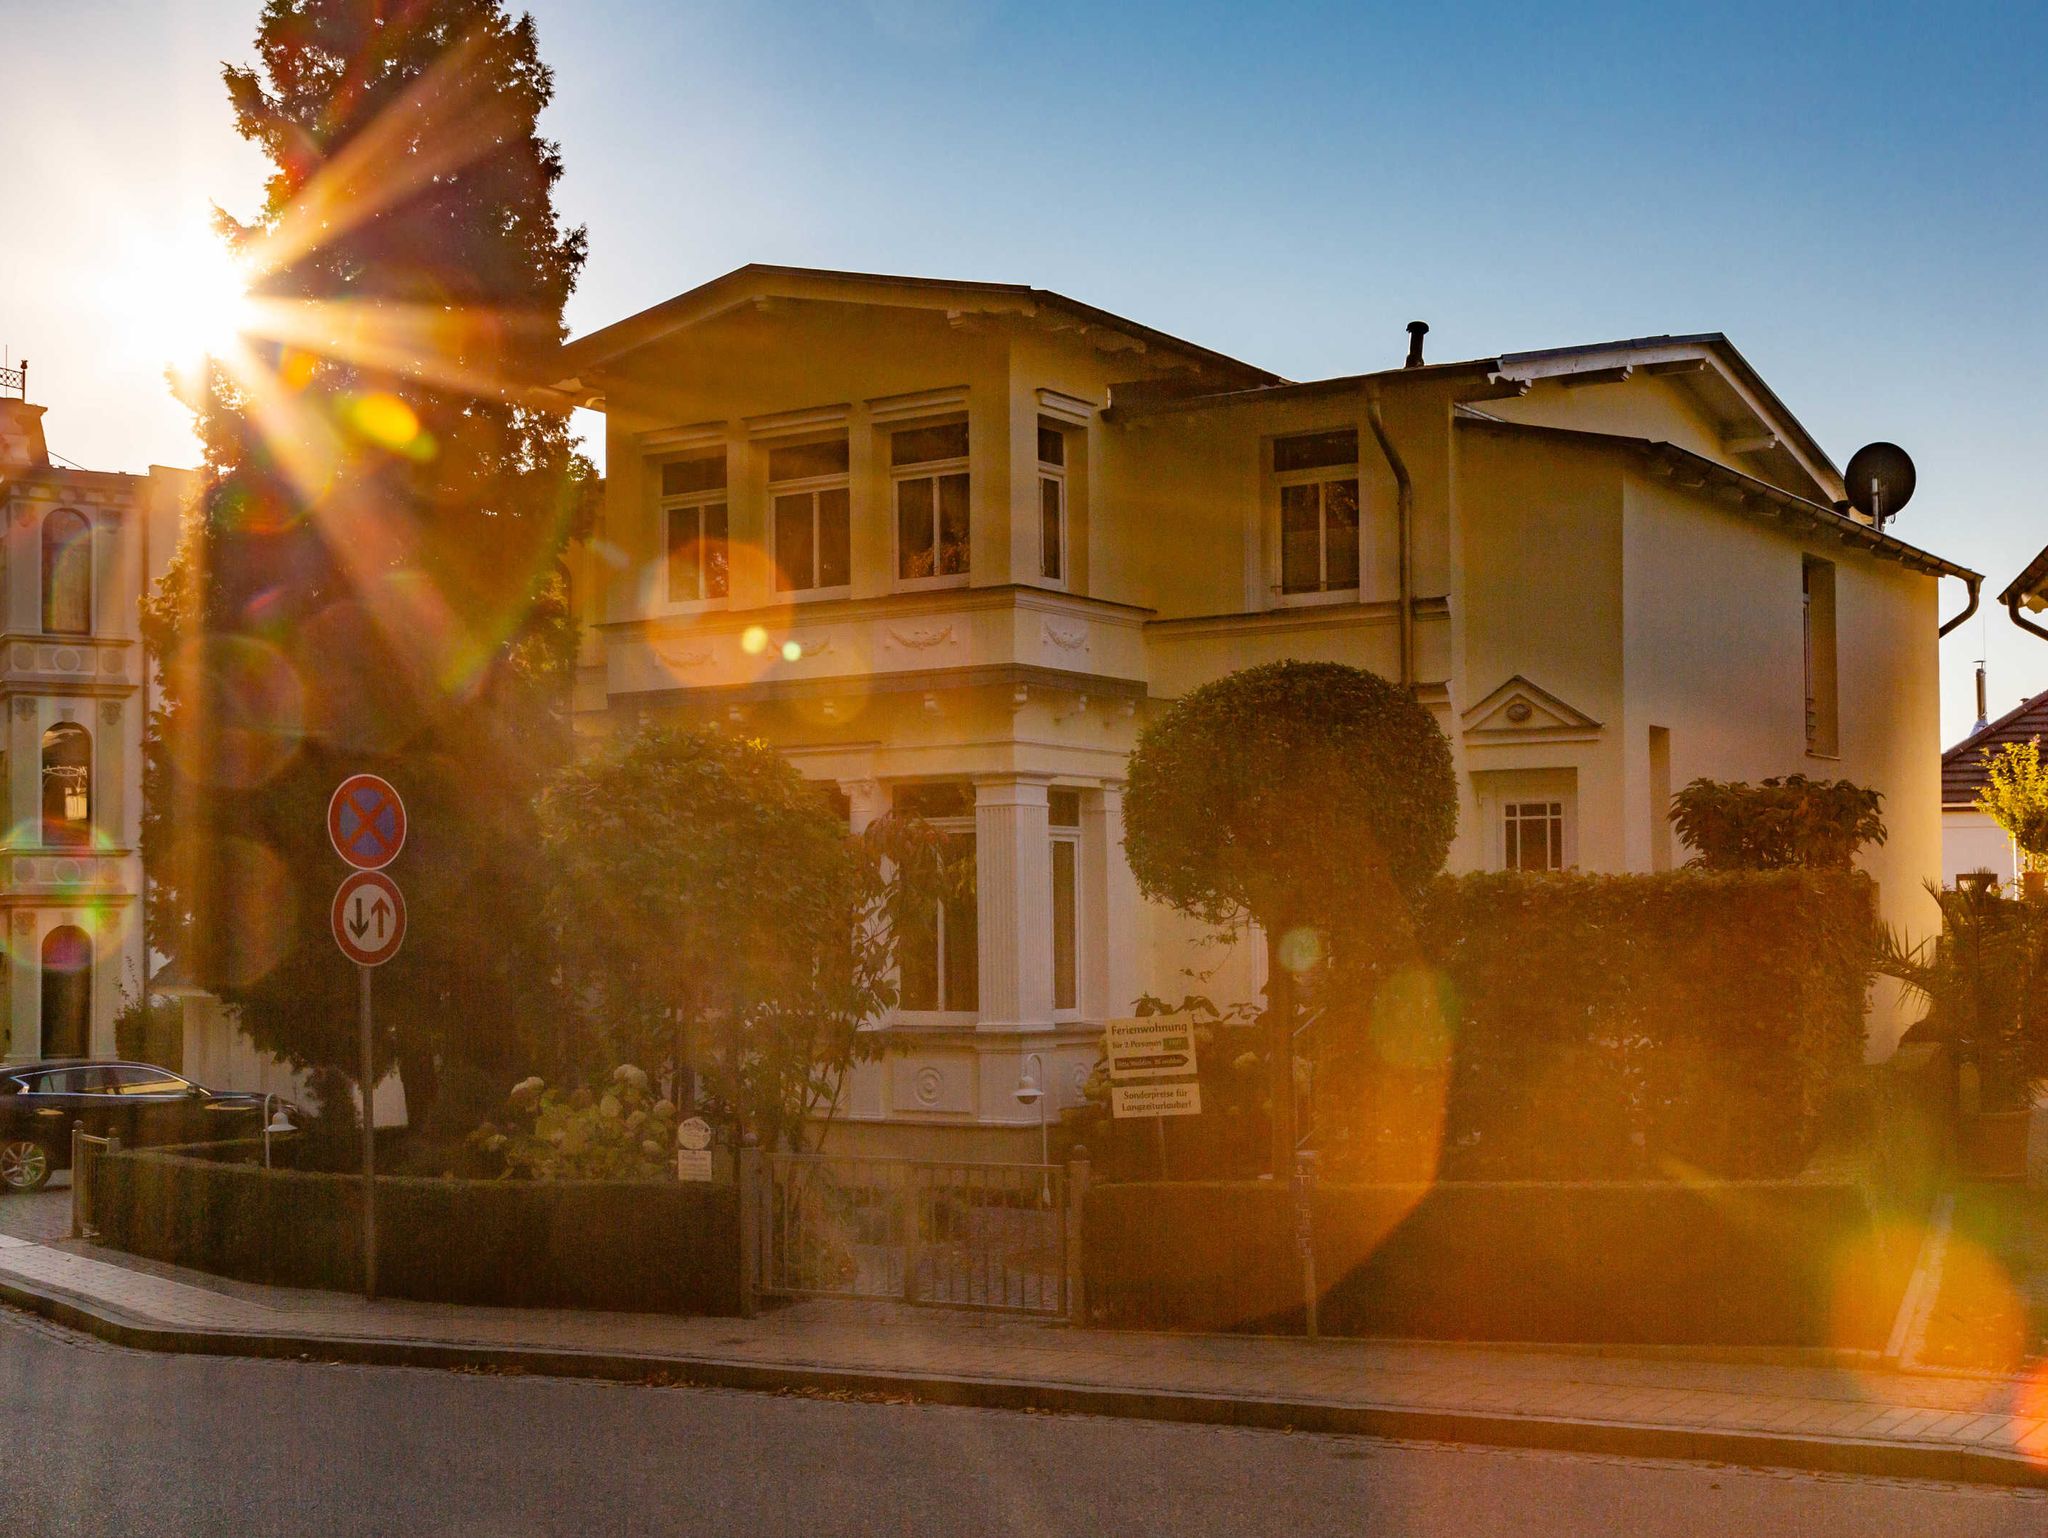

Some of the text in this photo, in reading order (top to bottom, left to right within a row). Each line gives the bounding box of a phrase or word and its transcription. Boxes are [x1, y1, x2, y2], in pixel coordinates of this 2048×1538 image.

[1112, 1023, 1187, 1035] Ferienwohnung
[1130, 1040, 1162, 1048] Personen
[1123, 1088, 1188, 1100] Sonderpreise für
[1122, 1100, 1192, 1112] Langzeiturlauber!
